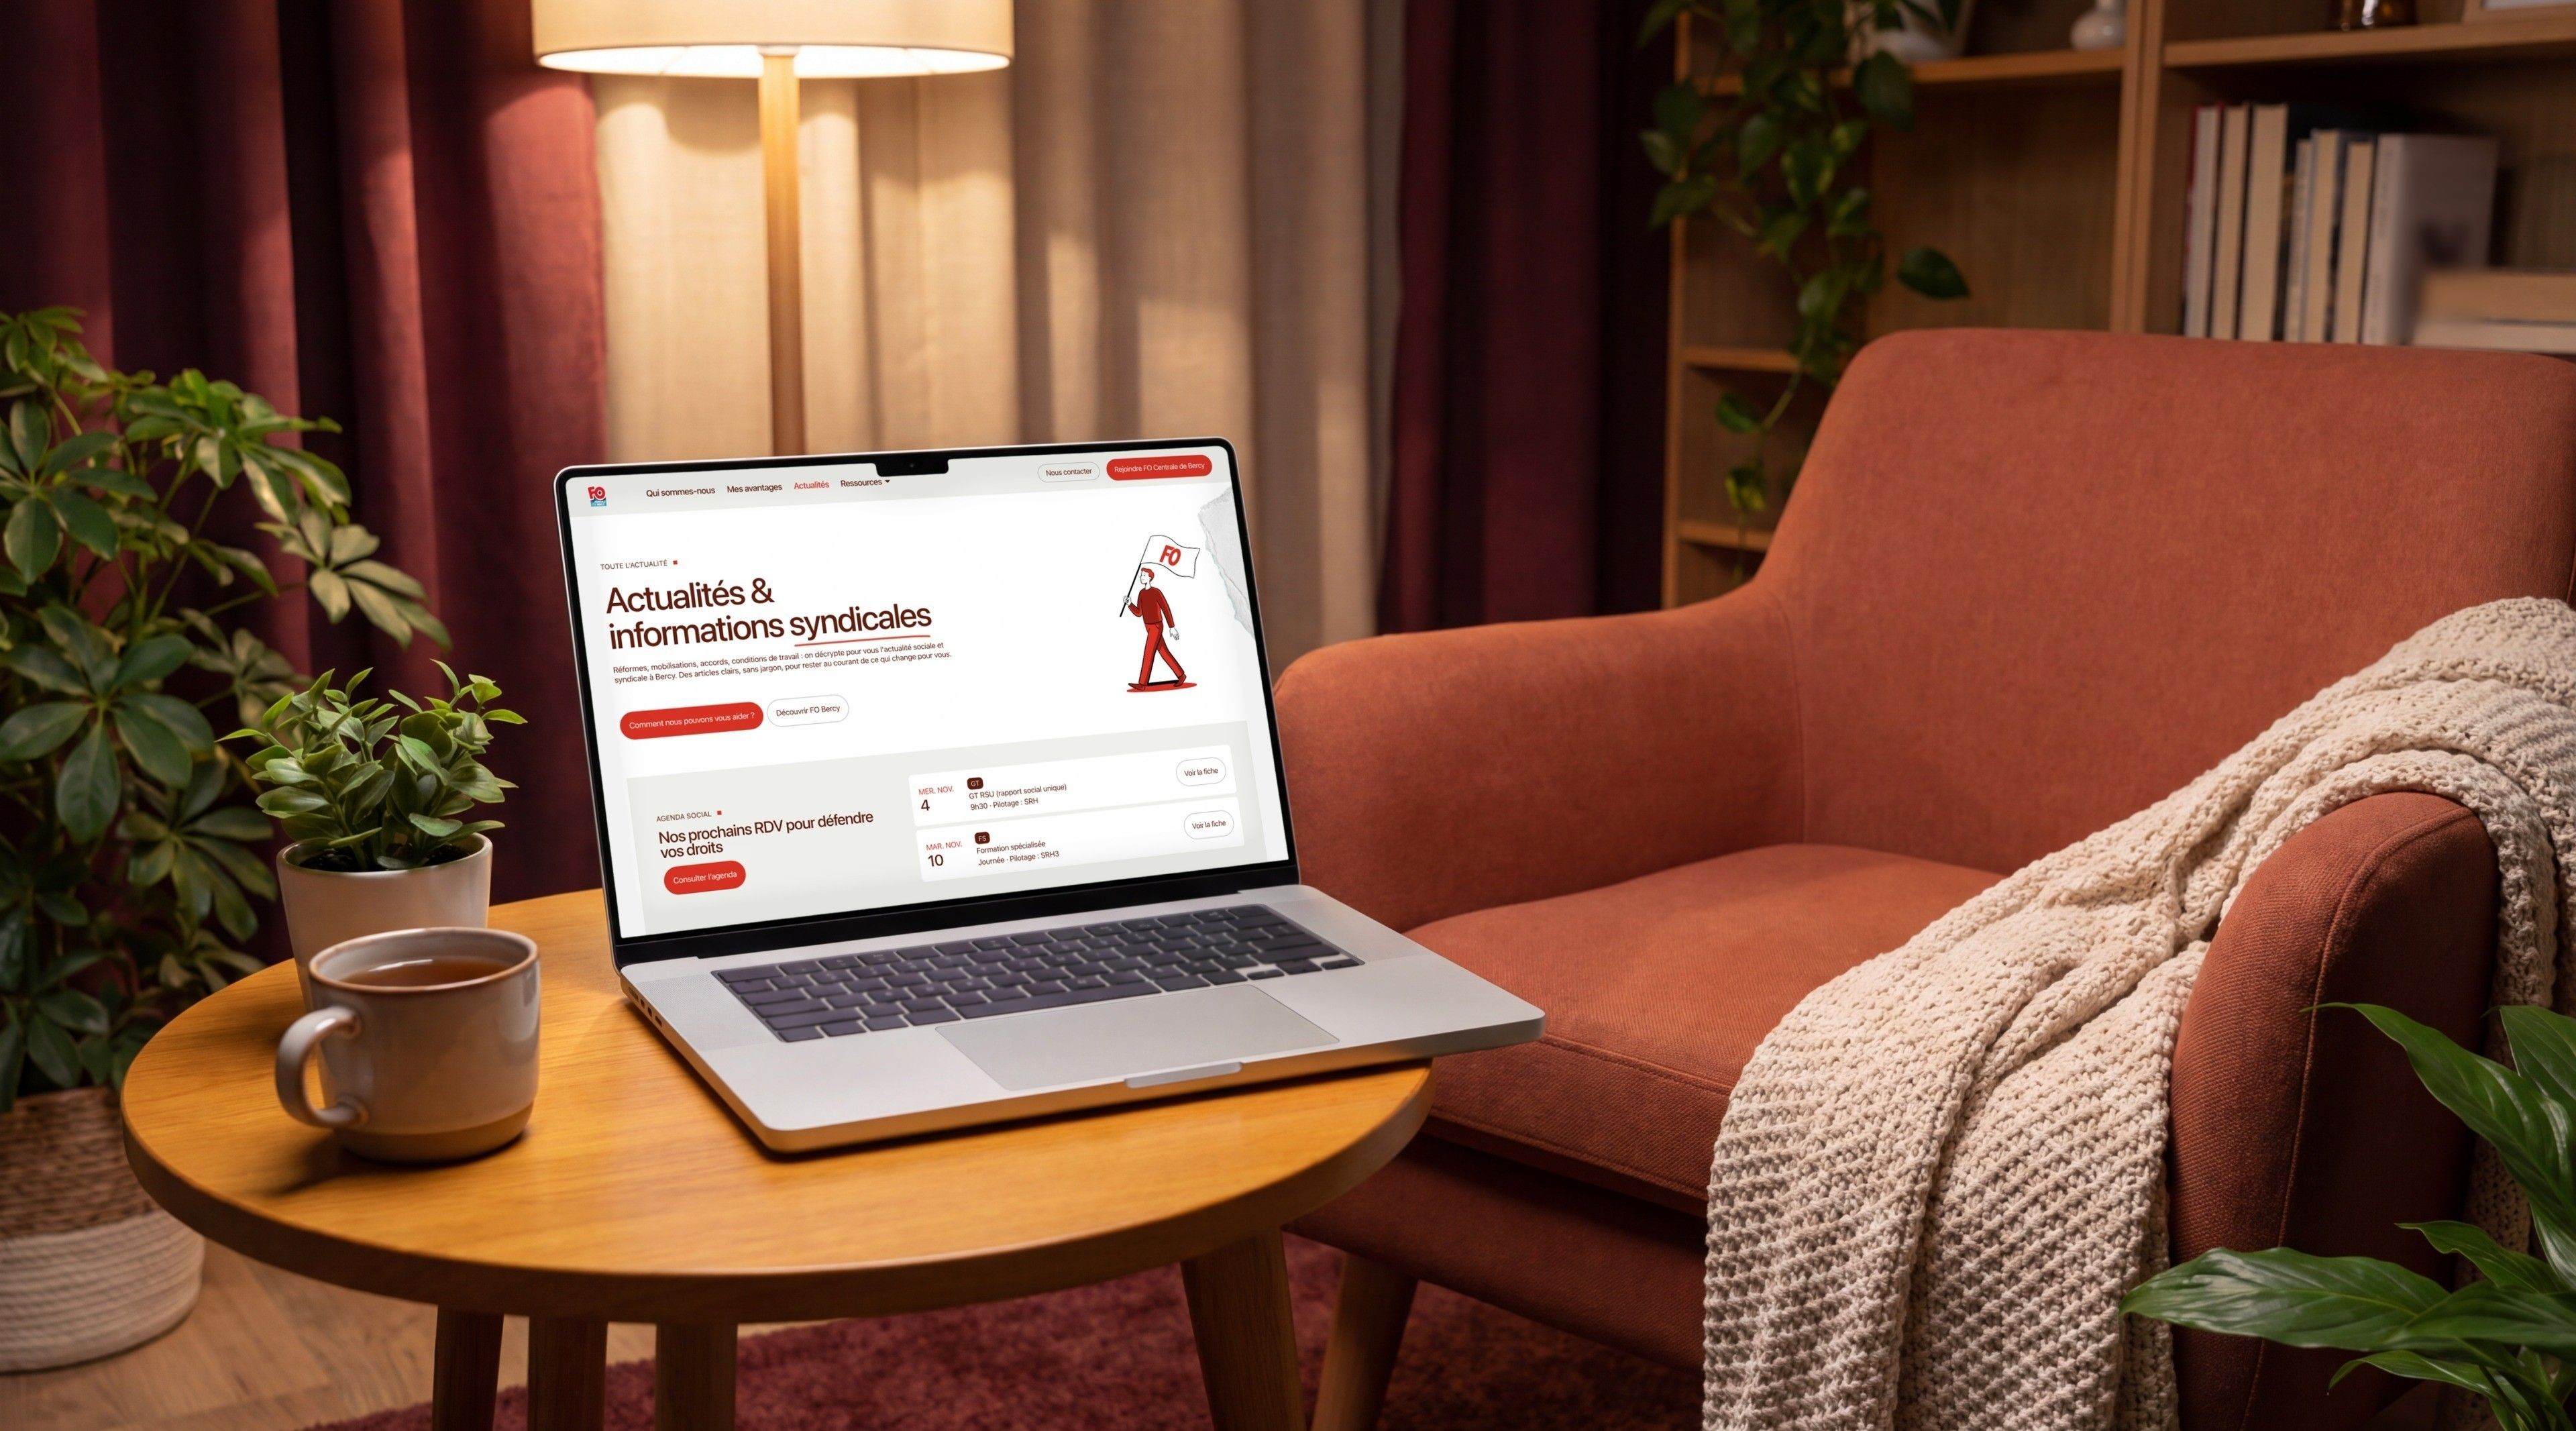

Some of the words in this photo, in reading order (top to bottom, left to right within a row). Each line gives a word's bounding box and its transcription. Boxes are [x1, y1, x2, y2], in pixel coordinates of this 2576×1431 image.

[1114, 466, 1142, 474] Rejoindre
[587, 486, 606, 500] FO
[646, 488, 660, 497] Qui
[660, 488, 716, 496] sommes-nous
[727, 485, 744, 493] Mes
[744, 484, 783, 492] avantages
[794, 480, 830, 490] Actualités
[840, 479, 883, 487] Ressources
[1159, 545, 1181, 566] FO
[600, 562, 624, 570] TOUTE
[606, 580, 746, 614] Actualités
[751, 578, 775, 604] &
[608, 615, 785, 649] informations
[790, 603, 932, 641] syndicales
[613, 666, 649, 674] Réformes,
[651, 661, 699, 670] mobilisations,
[700, 658, 730, 667] accords,
[731, 655, 767, 664] conditions
[779, 653, 800, 661] travail
[814, 649, 845, 658] décrypte
[913, 642, 936, 650] sociale
[614, 674, 648, 685] syndicale
[694, 669, 720, 678] articles
[759, 665, 784, 674] jargon,
[785, 664, 801, 672] pour
[833, 658, 859, 666] courant
[879, 655, 891, 664] qui
[775, 707, 808, 717] Découvrir
[629, 720, 664, 729] Comment
[684, 717, 713, 726] pouvons
[1184, 769, 1196, 777] Voir
[918, 787, 936, 795] MER.
[979, 790, 995, 798] RSU
[996, 788, 1022, 798] (rapport
[1023, 786, 1042, 794] social
[1042, 783, 1067, 792] unique)
[920, 799, 930, 811] 4
[970, 802, 988, 811] 9h30
[993, 800, 1019, 808] Pilotage
[656, 814, 686, 822] AGENDA
[686, 811, 712, 819] SOCIAL
[659, 831, 686, 844] Nos
[688, 824, 753, 845] prochains
[754, 819, 783, 835] RDV
[786, 819, 815, 834] pour
[818, 811, 873, 828] défendre
[660, 847, 684, 859] vos
[686, 841, 724, 856] droits
[926, 843, 945, 851] MAR.
[945, 841, 963, 849] NOV.
[976, 845, 1010, 854] Formation
[1010, 840, 1046, 851] spécialisée
[928, 854, 944, 867] 10
[978, 856, 1005, 866] Journée
[1009, 854, 1036, 862] Pilotage
[1040, 850, 1059, 859] SRH3
[673, 875, 707, 884] Consulter
